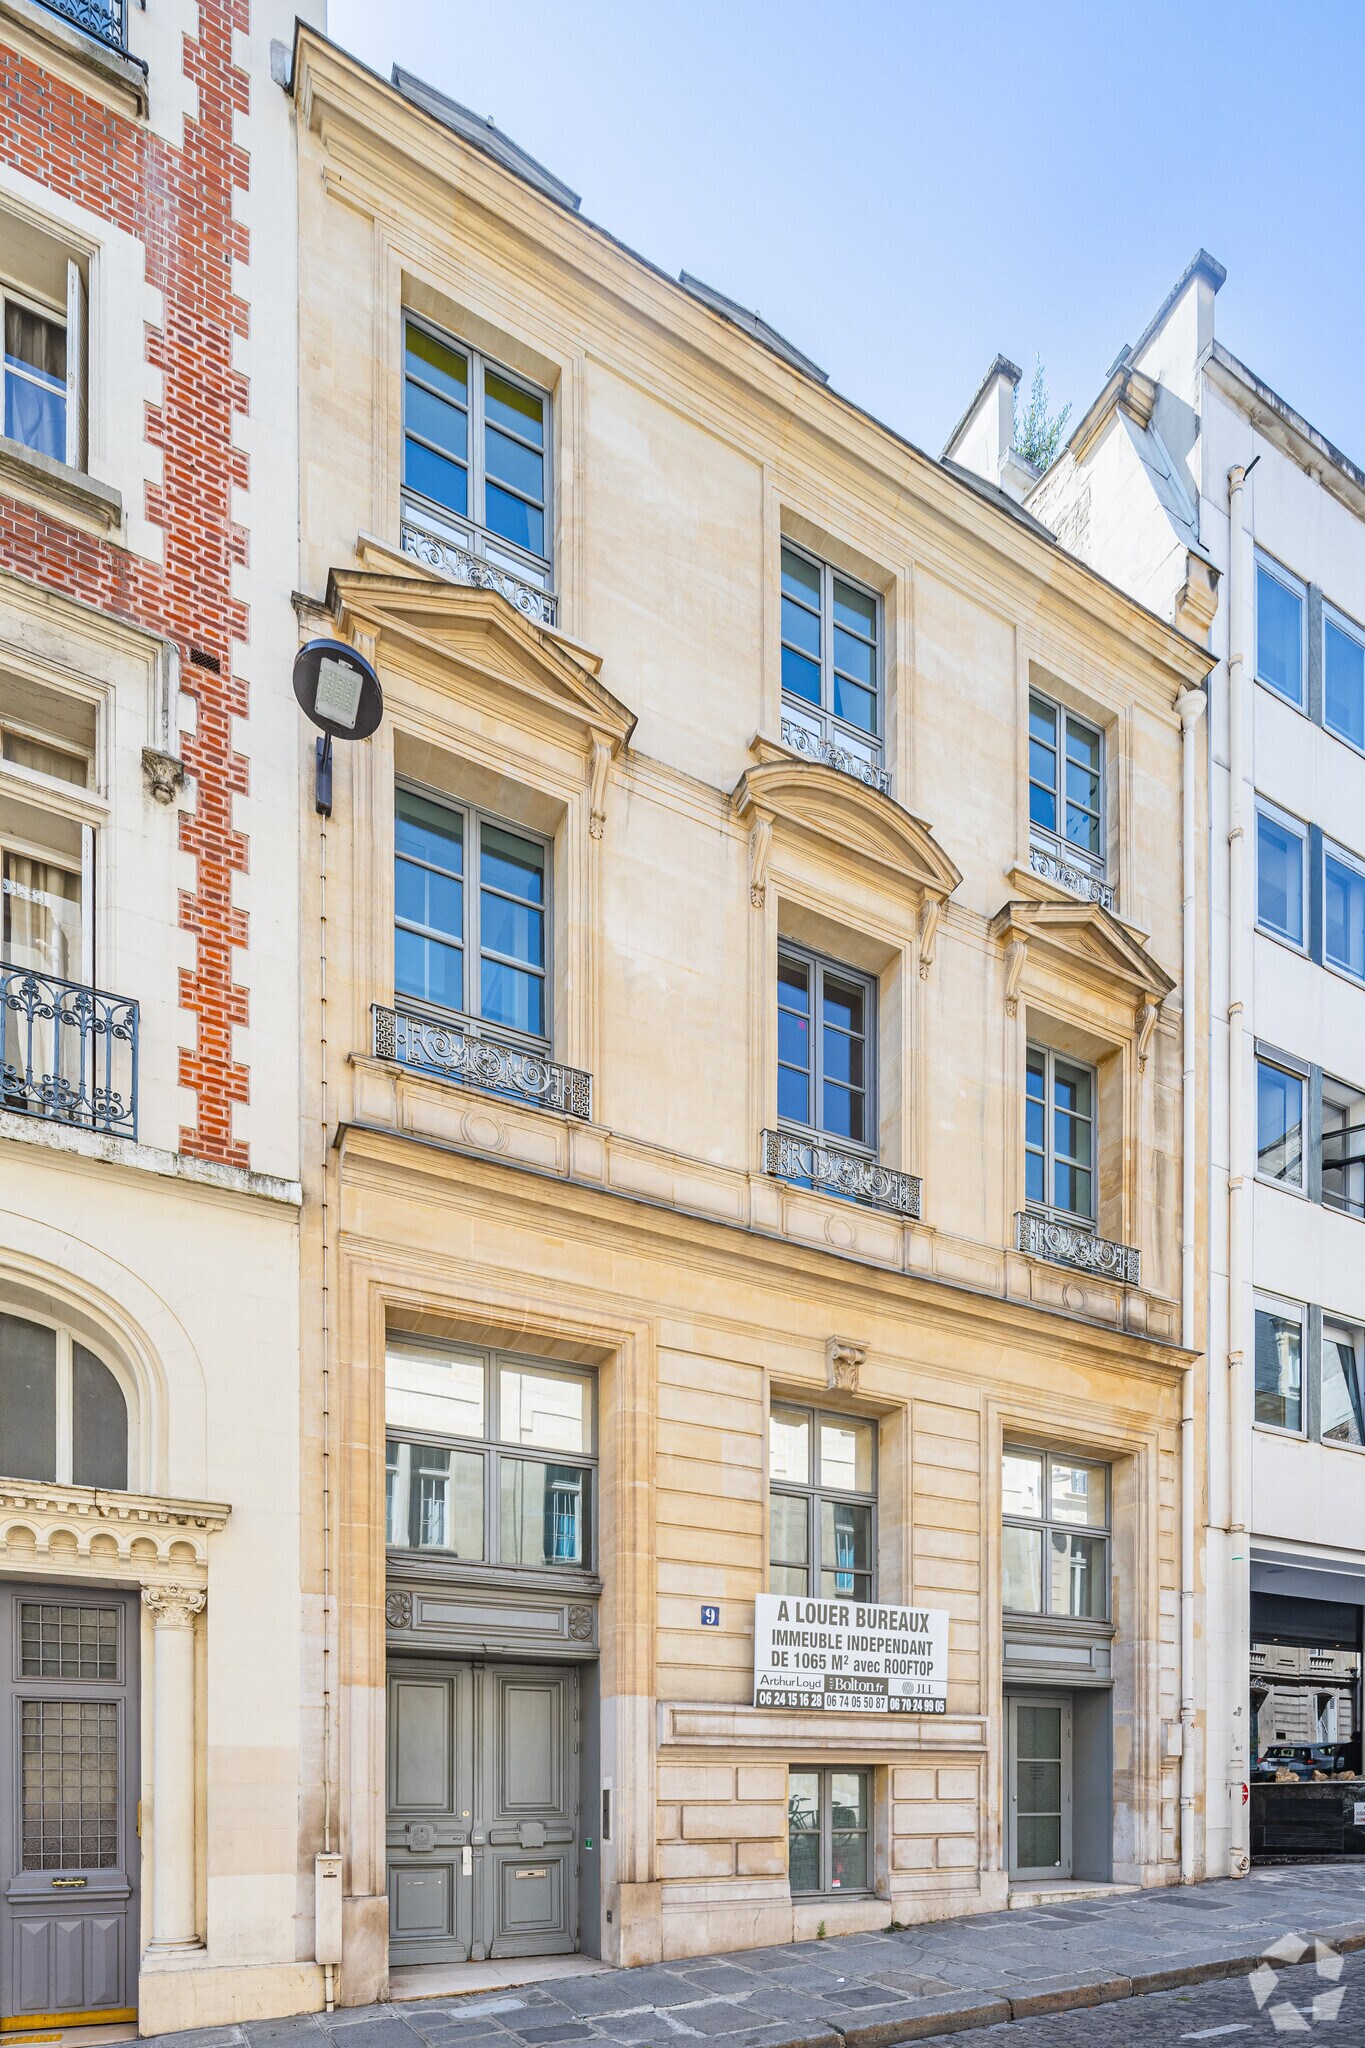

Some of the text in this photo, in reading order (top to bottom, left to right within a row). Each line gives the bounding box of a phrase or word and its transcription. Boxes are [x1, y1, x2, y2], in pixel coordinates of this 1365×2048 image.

[705, 1608, 715, 1624] 9
[778, 1601, 930, 1633] A LOUER BUREAUX
[772, 1629, 933, 1656] IMMEUBLE INDEPENDANT
[772, 1651, 788, 1667] DE
[794, 1652, 826, 1669] 1065
[853, 1660, 880, 1673] avec
[884, 1658, 934, 1676] ROOFTOP
[916, 1684, 934, 1694] JLL
[760, 1691, 822, 1707] 06 24 15 16 28
[826, 1694, 885, 1709] 06 74 05 50 87
